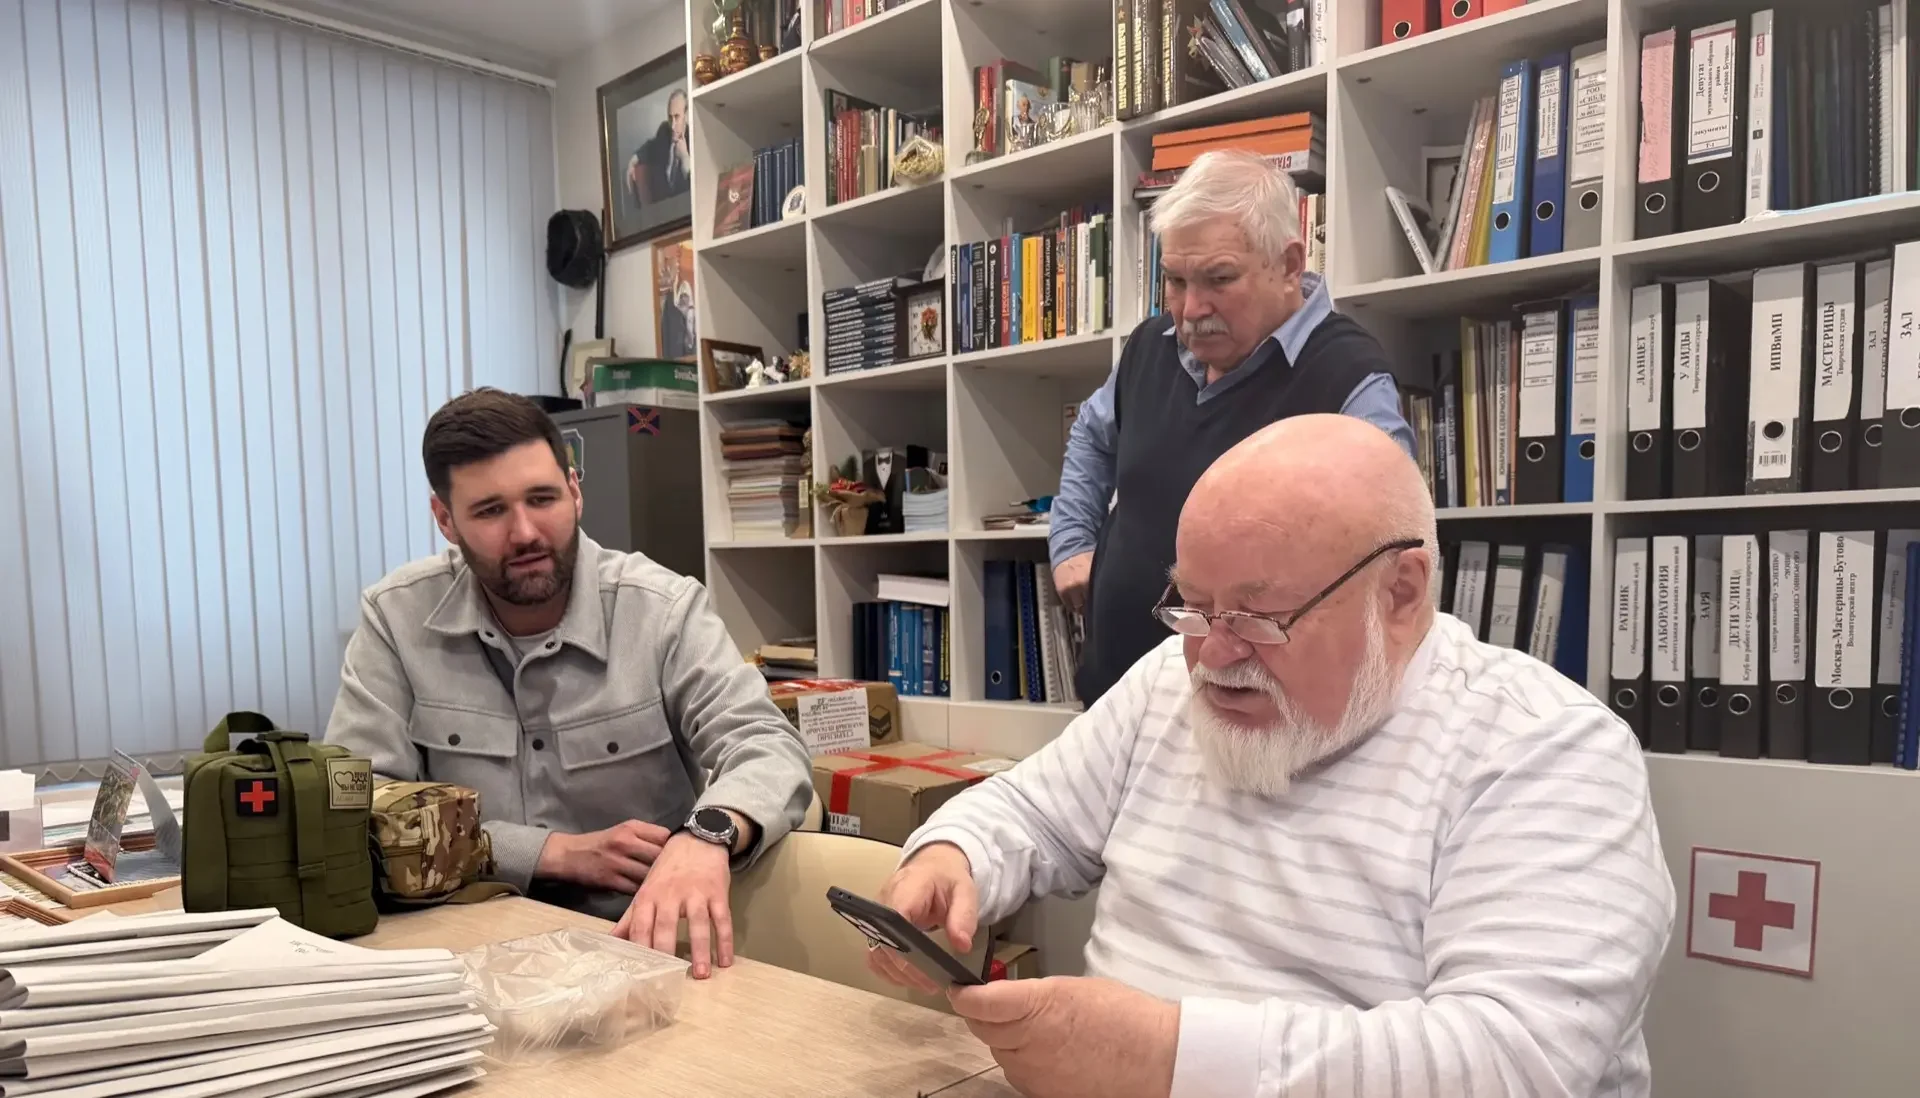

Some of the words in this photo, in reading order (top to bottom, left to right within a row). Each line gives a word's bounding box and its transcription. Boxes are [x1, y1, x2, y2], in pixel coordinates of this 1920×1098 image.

[1118, 57, 1126, 66] К
[1696, 63, 1705, 97] Депутат
[1044, 278, 1052, 306] Русская
[1868, 330, 1876, 351] ЗАЛ
[1900, 311, 1913, 339] ЗАЛ
[1636, 335, 1646, 386] ЛАНЦЕТ
[1680, 331, 1691, 368] АИДЫ
[1821, 301, 1835, 387] МАСТЕРИЦЫ
[1836, 334, 1846, 376] Творческая
[1680, 372, 1689, 380] У
[1849, 572, 1857, 595] центр
[1619, 585, 1629, 631] РАТНИК
[1658, 565, 1669, 654] ЛАБОРАТОРИЯ
[1700, 591, 1710, 620] ЗАРЯ
[1831, 536, 1847, 685] Москва-Мастерицы-Бутово
[1847, 596, 1856, 648] Волонтерский
[1729, 614, 1740, 648] ДЕТИ
[1742, 664, 1750, 681] Клуб
